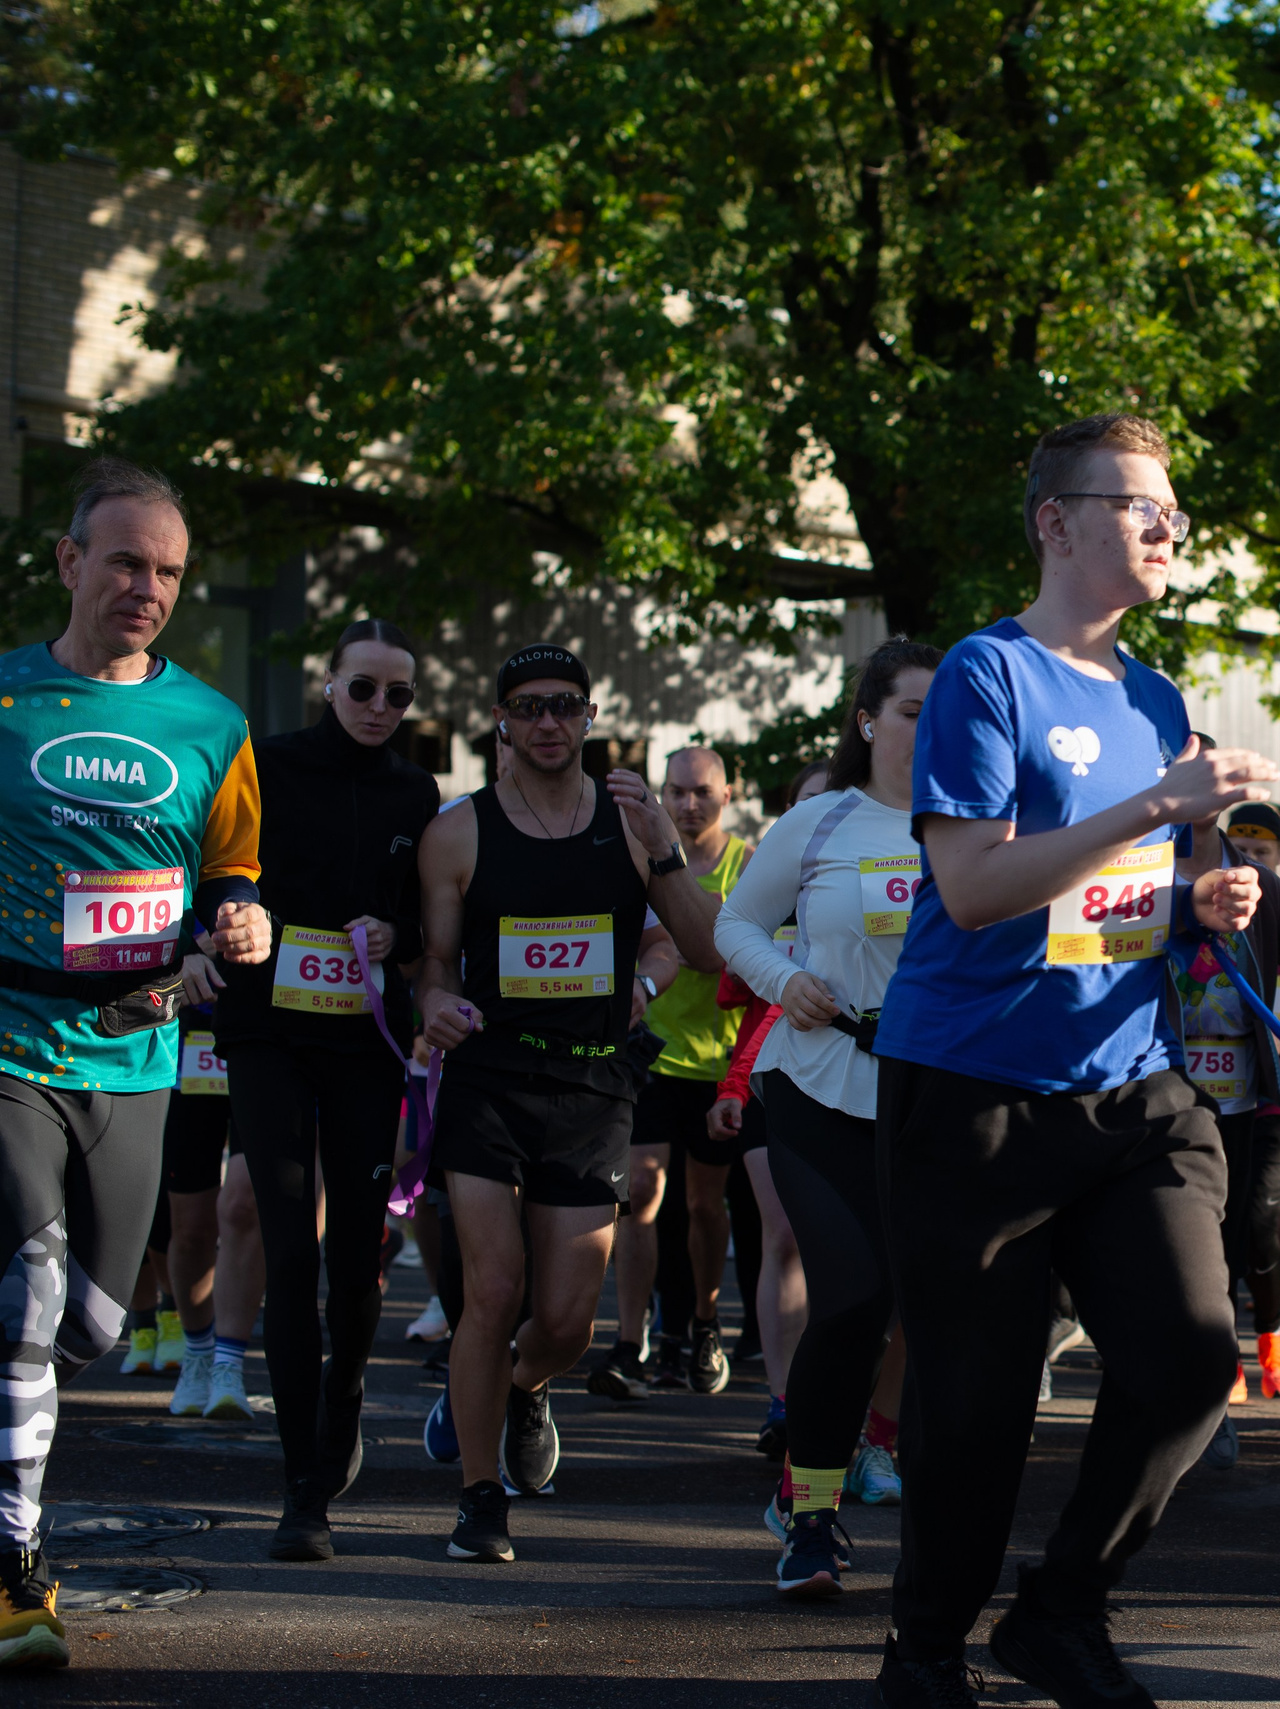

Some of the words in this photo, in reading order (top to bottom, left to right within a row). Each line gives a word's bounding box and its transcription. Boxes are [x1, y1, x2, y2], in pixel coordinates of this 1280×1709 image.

[510, 651, 573, 667] SALOMON
[65, 755, 147, 786] IMMA
[50, 804, 110, 827] SPORT
[113, 814, 159, 833] TEAM
[1082, 882, 1155, 922] 848
[85, 899, 171, 934] 1019
[514, 919, 573, 931] ИНКЛЮЗИВНЫЙ
[575, 919, 598, 929] ЗАБЕГ
[116, 950, 131, 963] 11
[524, 941, 590, 969] 627
[1100, 939, 1123, 956] 5,5
[299, 954, 364, 985] 639
[539, 982, 561, 994] 5,5
[312, 995, 334, 1009] 5,5
[1187, 1051, 1235, 1074] 758
